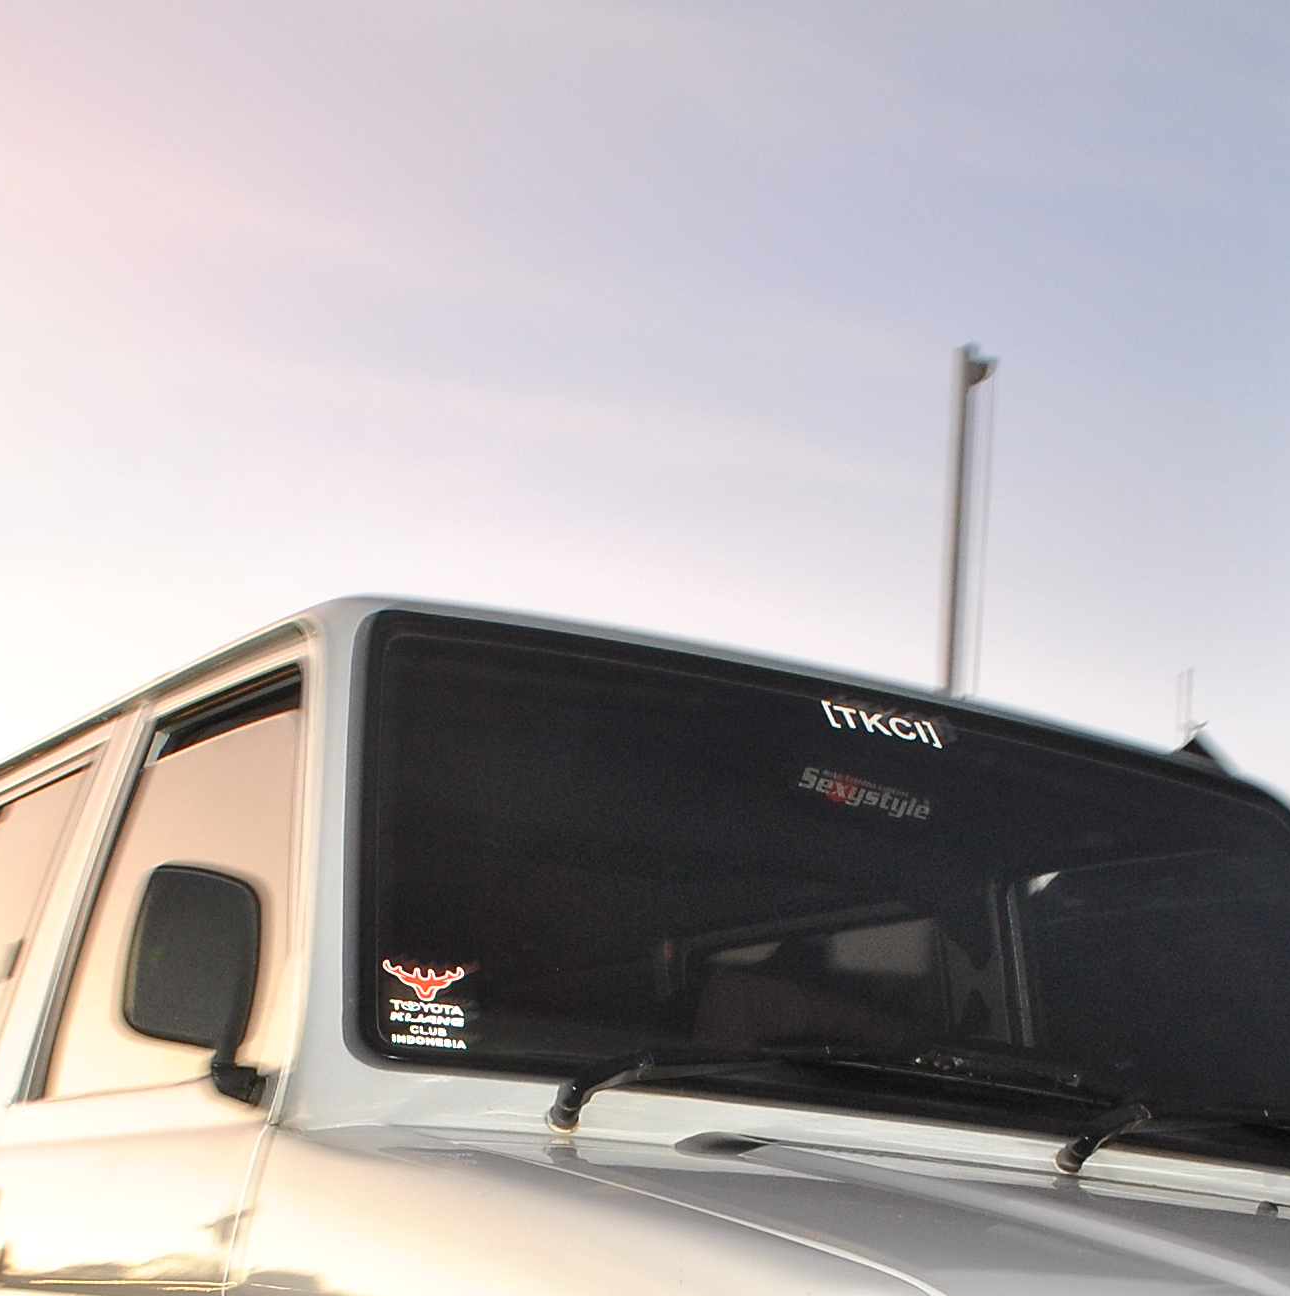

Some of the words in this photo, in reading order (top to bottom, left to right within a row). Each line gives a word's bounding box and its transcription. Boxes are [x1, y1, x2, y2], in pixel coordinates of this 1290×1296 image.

[821, 699, 943, 749] [TKCI]
[798, 766, 931, 820] Sexystyle
[389, 998, 465, 1017] TOYOTA
[409, 1024, 447, 1038] CLUB
[391, 1033, 467, 1050] INDONESIA
